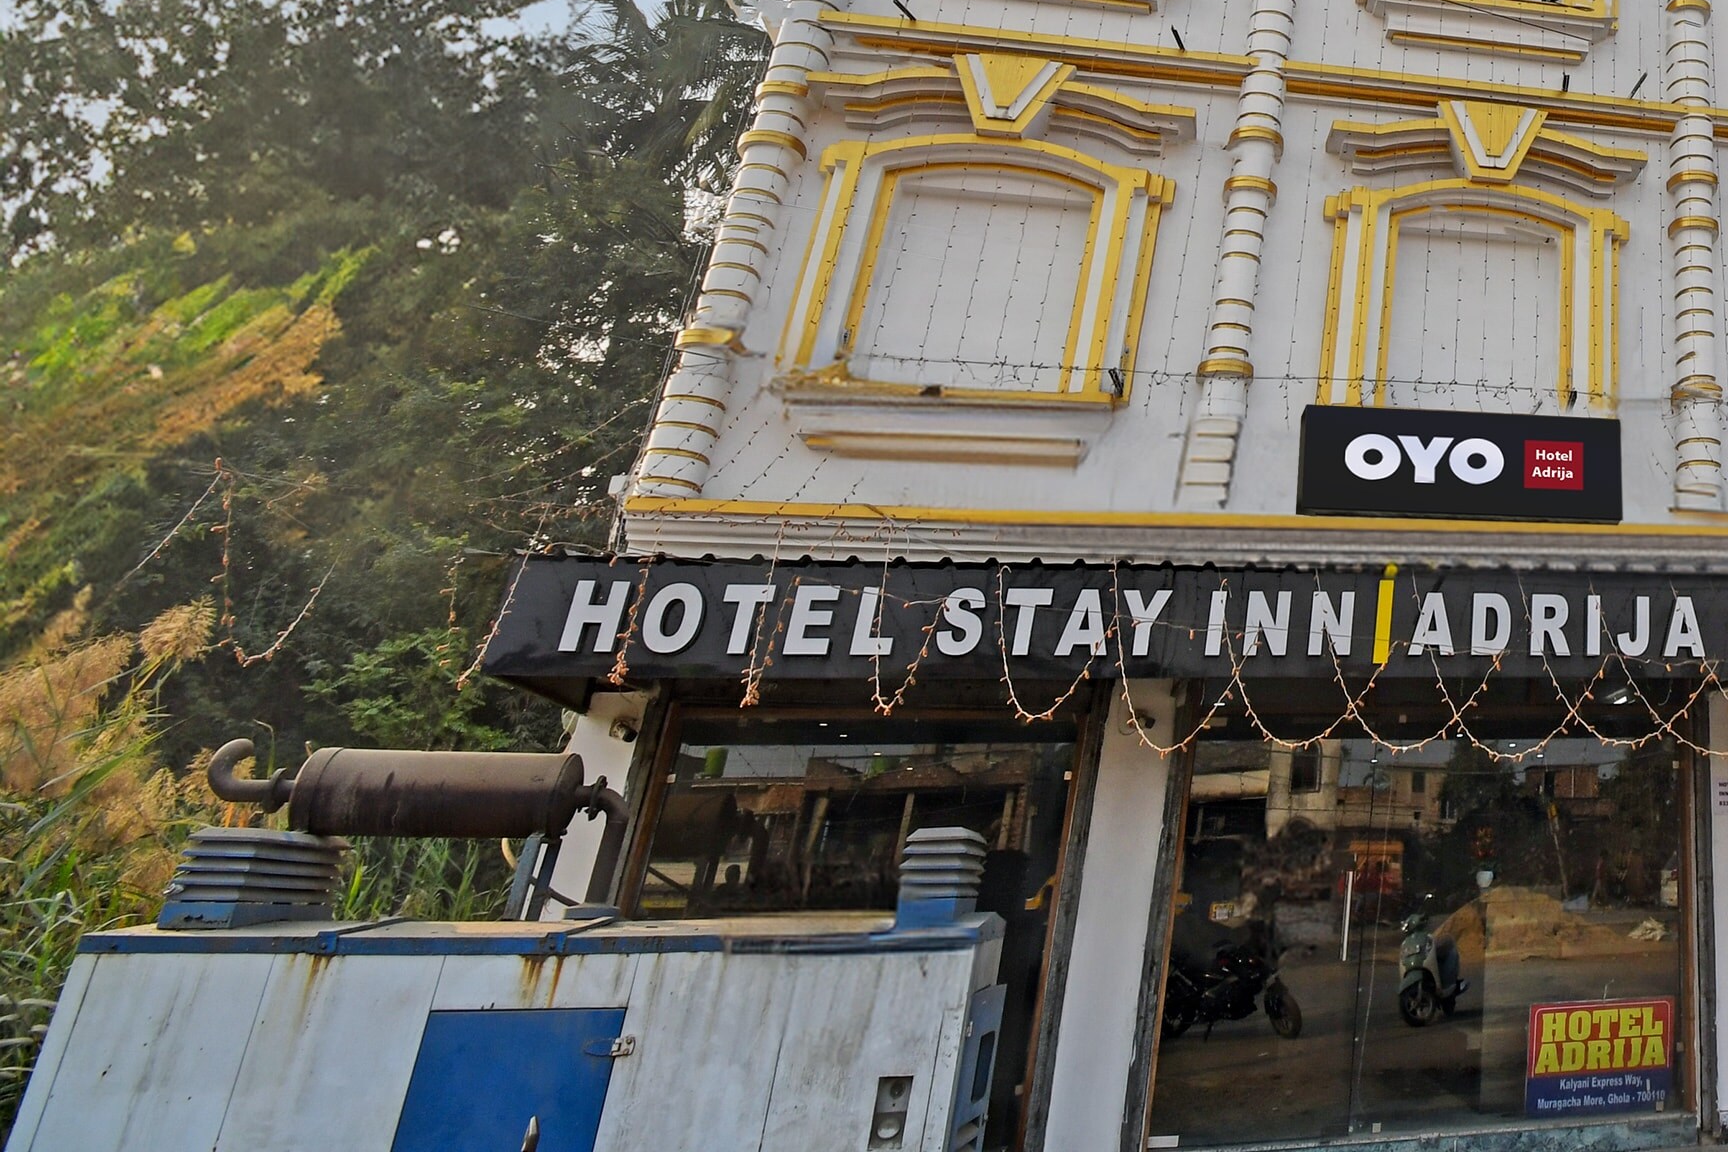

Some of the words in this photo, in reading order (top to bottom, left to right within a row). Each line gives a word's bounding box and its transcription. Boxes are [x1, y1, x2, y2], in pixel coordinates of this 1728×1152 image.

[1345, 433, 1505, 485] OYO
[1532, 466, 1574, 481] Adrija
[1535, 449, 1573, 462] Hotel
[558, 579, 894, 656] HOTEL
[935, 587, 1174, 657] STAY
[1204, 590, 1356, 657] INN
[1407, 591, 1707, 658] ADRIJA
[1541, 1006, 1664, 1043] HOTEL
[1534, 1035, 1666, 1075] ADRIJA
[1537, 1097, 1581, 1111] Muragacha
[1583, 1094, 1606, 1107] More,
[1607, 1092, 1631, 1105] Ghola
[1560, 1077, 1590, 1092] Kalyani
[1591, 1075, 1623, 1090] Express
[1624, 1074, 1643, 1088] Way,
